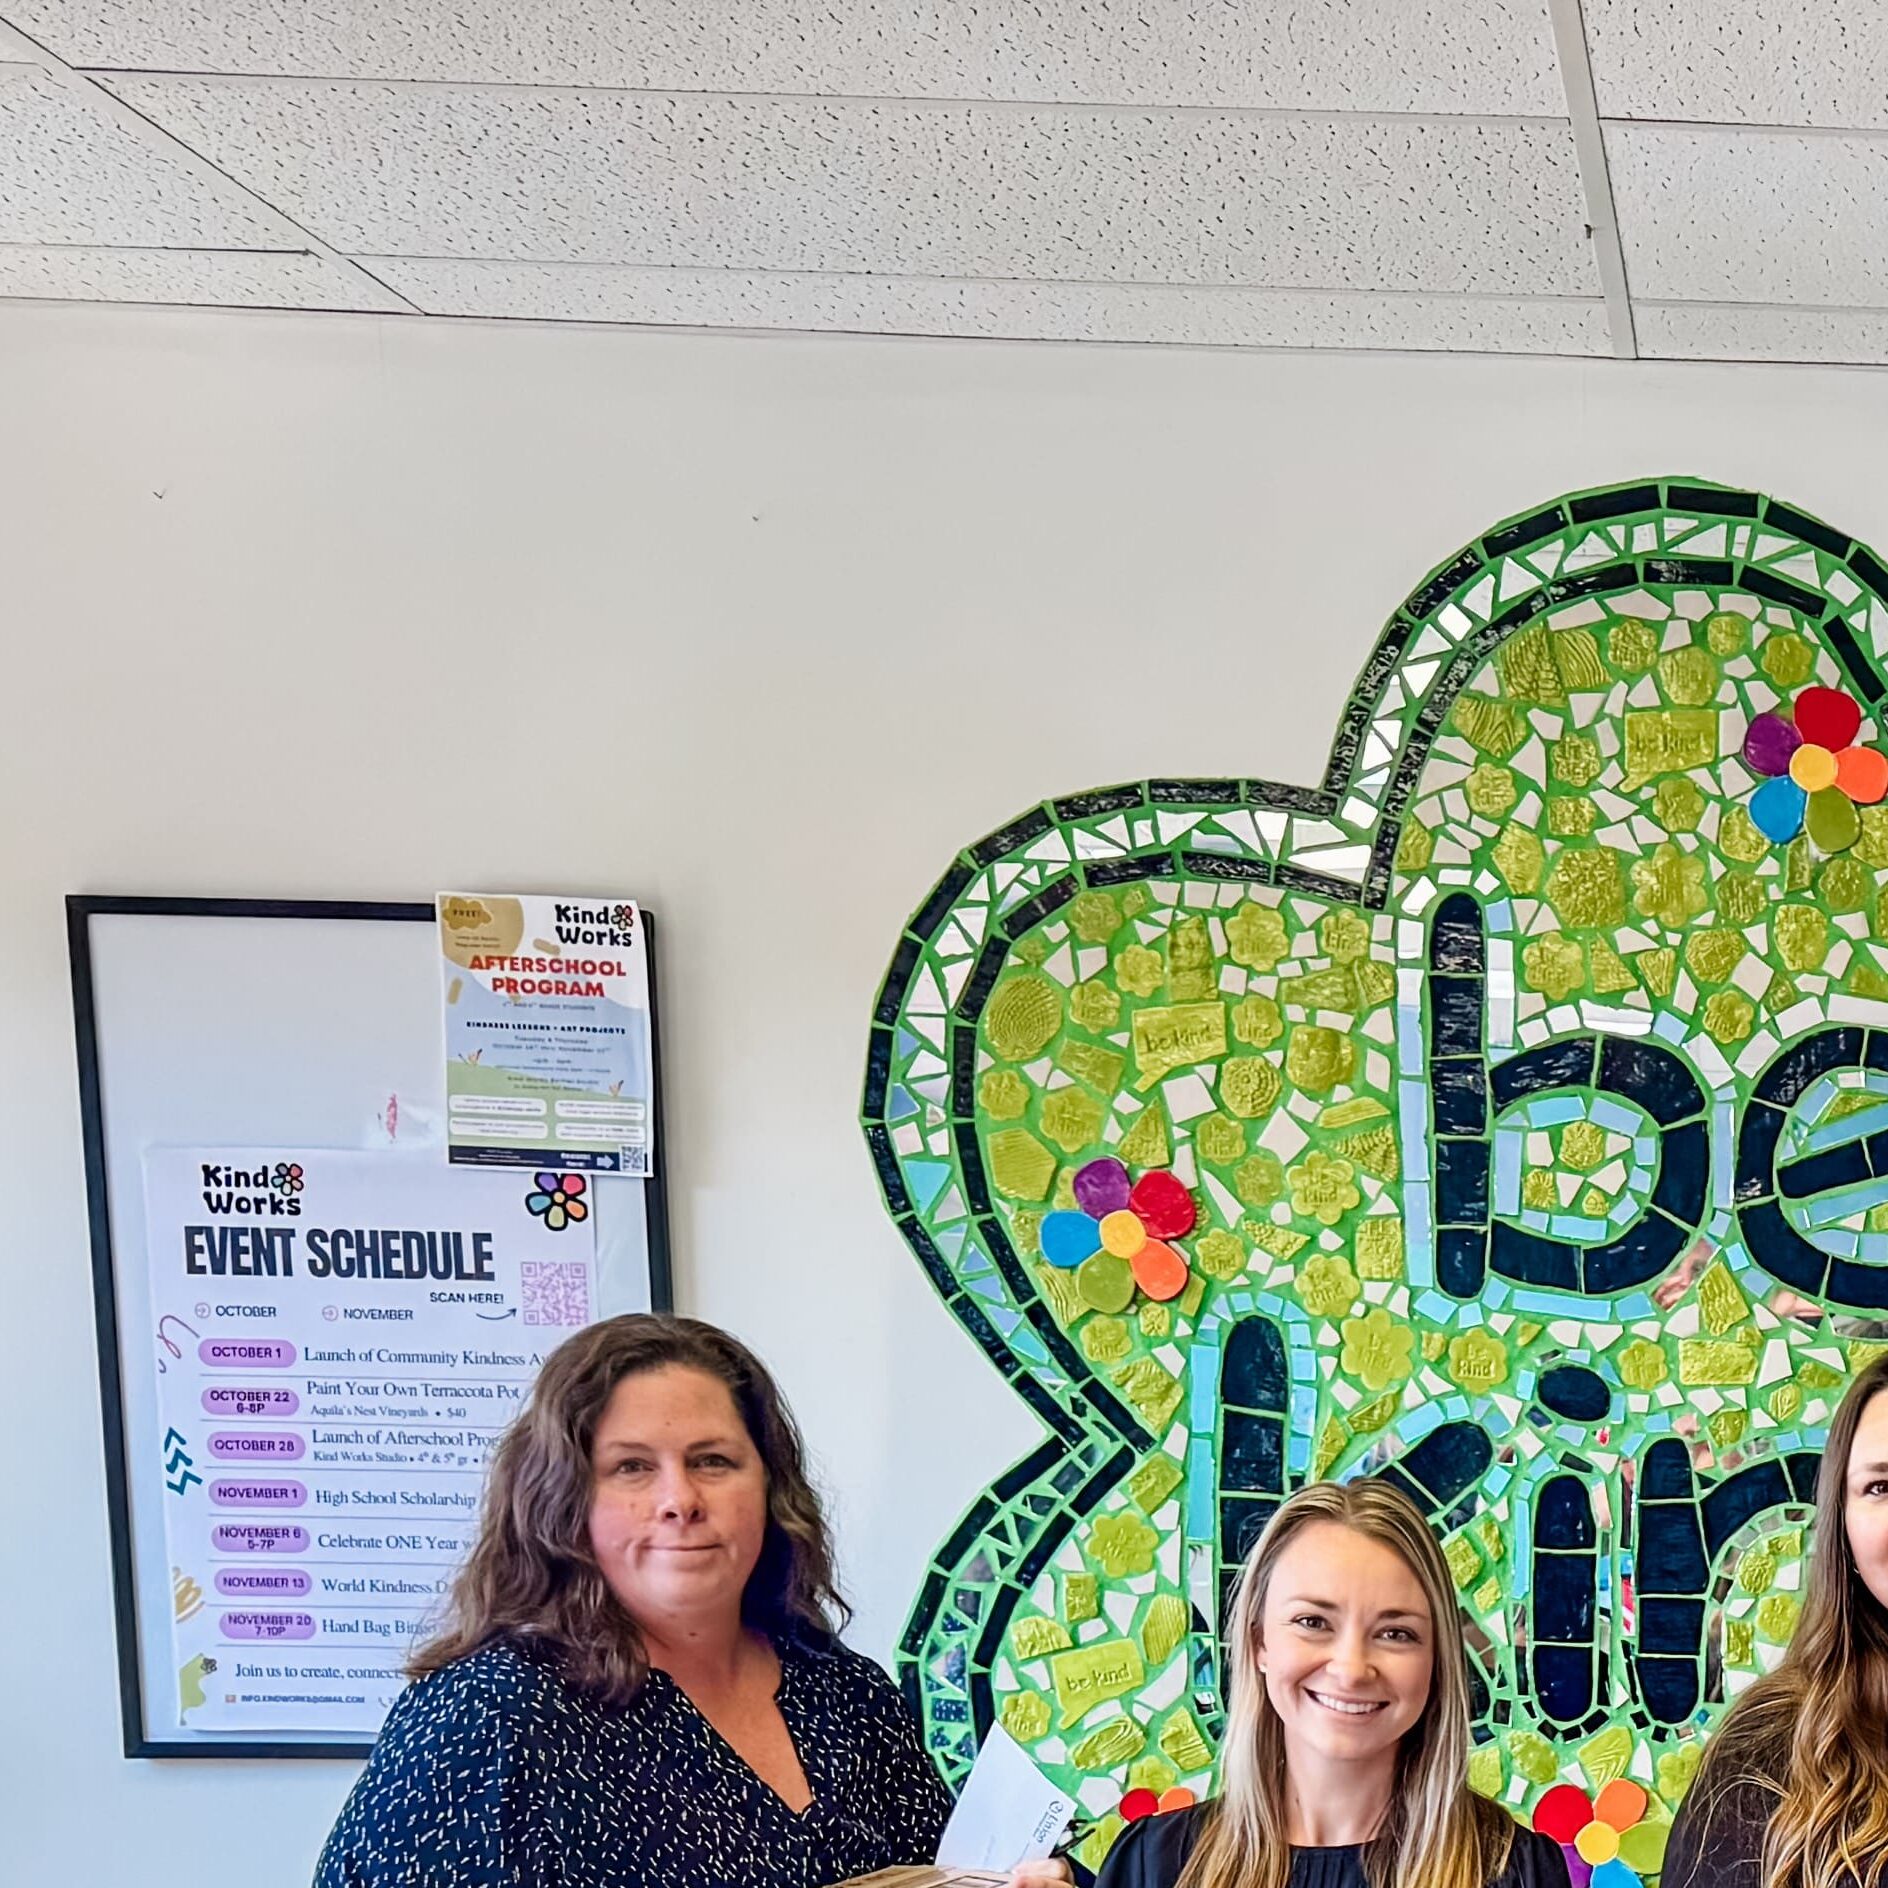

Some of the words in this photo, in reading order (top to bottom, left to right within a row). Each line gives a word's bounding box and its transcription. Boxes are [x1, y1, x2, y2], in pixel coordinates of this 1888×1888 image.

[555, 904, 609, 924] Kind
[555, 926, 632, 947] Works
[469, 955, 627, 977] AFTERSCHOOL
[492, 977, 605, 998] PROGRAM
[202, 1164, 270, 1189] Kind
[202, 1191, 302, 1216] Works
[184, 1226, 297, 1277] EVENT
[306, 1229, 496, 1282] SCHEDULE
[429, 1292, 466, 1304] SCAN
[468, 1293, 504, 1305] HERE!
[215, 1306, 277, 1318] OCTOBER
[343, 1308, 414, 1321] NOVEMBER
[211, 1346, 273, 1359] OCTOBER
[276, 1347, 282, 1359] 1
[304, 1347, 356, 1362] Launch
[358, 1349, 373, 1362] of
[376, 1348, 459, 1368] Community
[463, 1350, 526, 1367] Kindness
[210, 1389, 271, 1402] OCTOBER
[274, 1391, 290, 1403] 22
[306, 1380, 342, 1396] Paint
[345, 1381, 380, 1396] Your
[383, 1382, 418, 1397] Own
[496, 1384, 520, 1400] Pot
[214, 1439, 276, 1451] OCTOBER
[312, 1429, 364, 1444] Launch
[367, 1430, 383, 1445] of
[386, 1431, 463, 1447] Afterschool
[313, 1451, 338, 1462] Kind
[217, 1487, 289, 1499] NOVEMBER
[292, 1488, 298, 1499] 1
[315, 1490, 349, 1507] High
[351, 1491, 397, 1505] School
[400, 1491, 477, 1509] Scholarship
[219, 1527, 290, 1539] NOVEMBER
[318, 1533, 383, 1549] Celebrate
[385, 1535, 423, 1550] ONE
[425, 1536, 458, 1550] Year
[222, 1576, 289, 1588] NOVEMBER
[292, 1578, 305, 1589] 13
[321, 1578, 365, 1593] World
[369, 1579, 433, 1594] Kindness
[227, 1614, 294, 1626] NOVEMBER
[296, 1615, 312, 1626] 20
[322, 1619, 360, 1634] Hand
[363, 1619, 391, 1637] Bag
[235, 1663, 263, 1679] Join
[266, 1666, 282, 1678] us
[284, 1665, 299, 1678] to
[301, 1666, 345, 1680] create,
